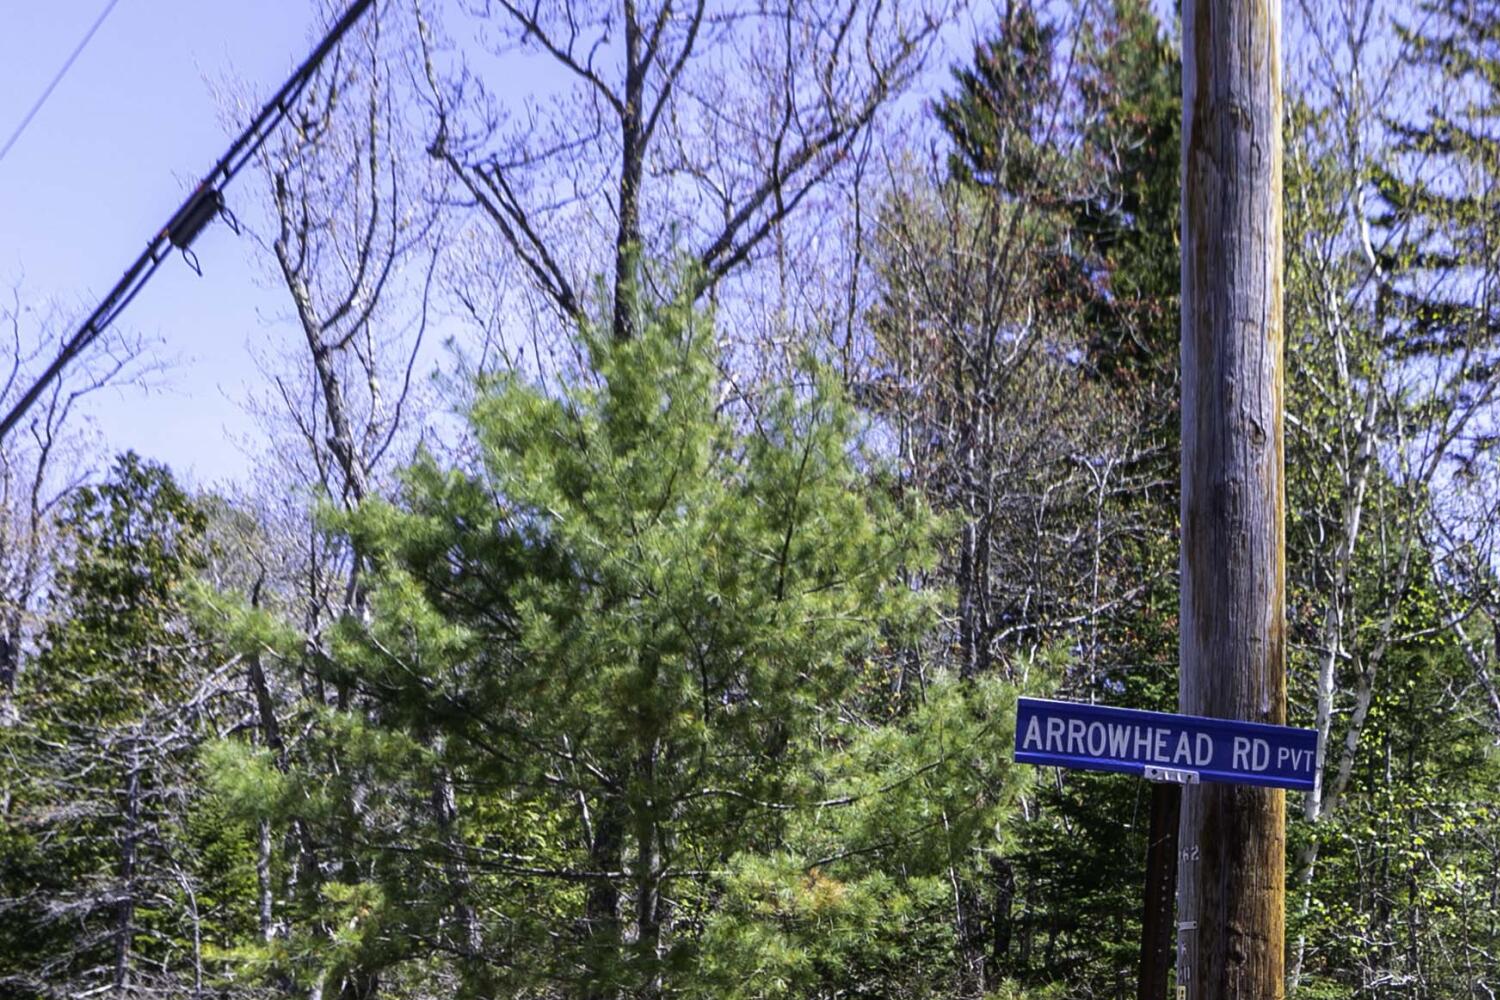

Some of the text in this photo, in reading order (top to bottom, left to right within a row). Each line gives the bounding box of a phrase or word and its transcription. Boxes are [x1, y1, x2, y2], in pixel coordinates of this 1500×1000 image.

[1022, 714, 1314, 773] ARROWHEAD RD PVT
